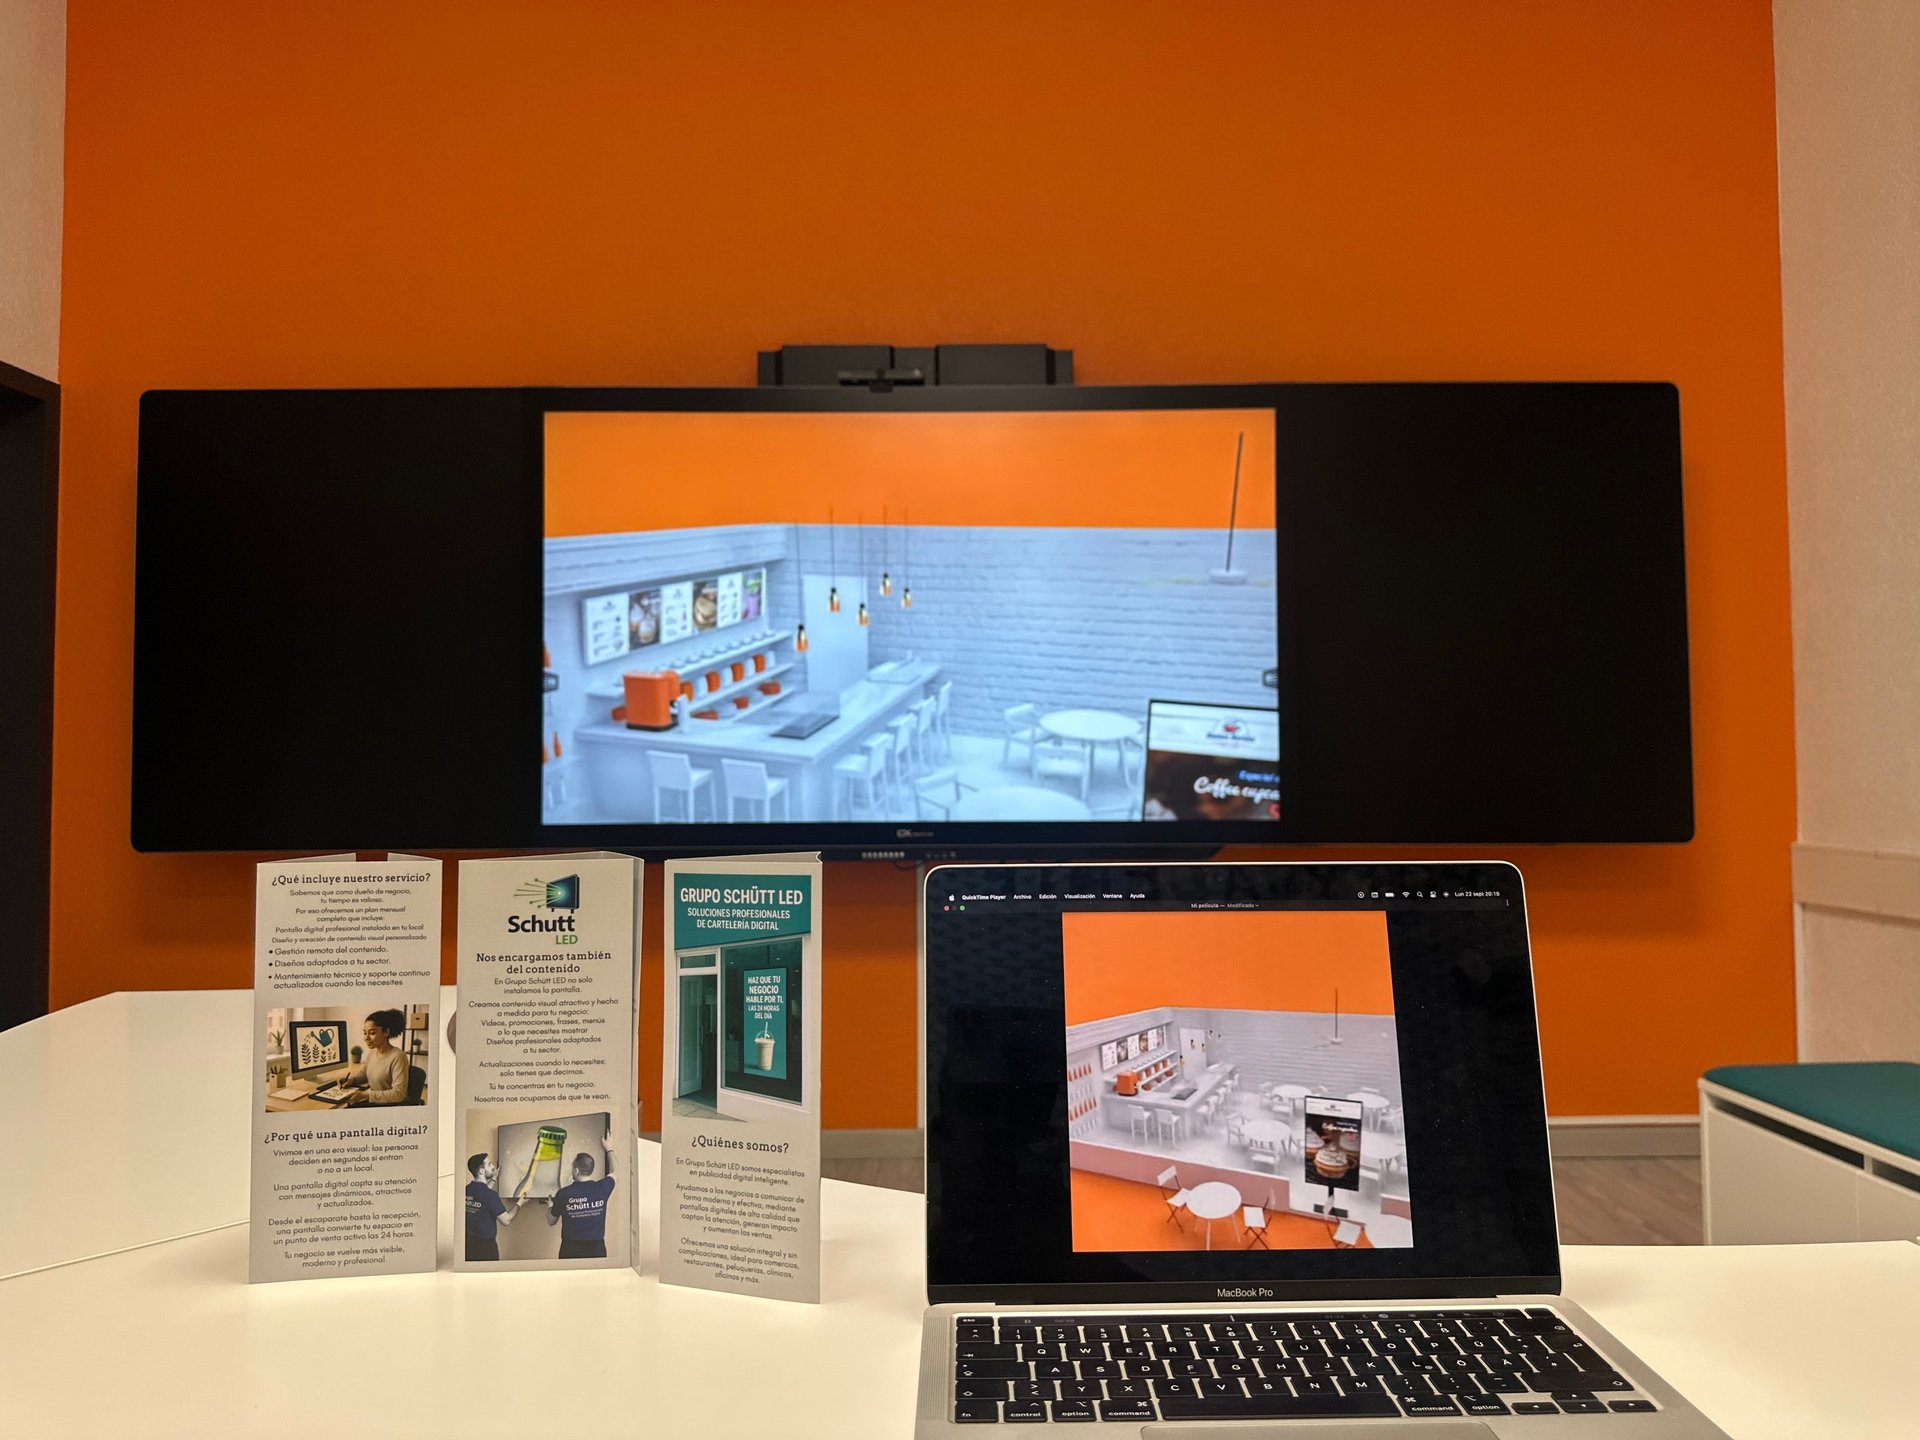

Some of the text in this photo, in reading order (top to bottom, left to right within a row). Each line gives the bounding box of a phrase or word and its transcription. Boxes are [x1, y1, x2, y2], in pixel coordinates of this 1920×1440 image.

[1194, 776, 1240, 798] Coffee
[271, 875, 299, 886] ¿Qué
[302, 874, 340, 884] incluye
[385, 873, 430, 882] servicio?
[680, 886, 802, 904] GRUPO SCHÜTT LED
[687, 907, 790, 918] SOLUCIONES PROFESIONALES
[508, 915, 575, 932] Schutt
[696, 919, 778, 930] DE CARTELERÍA DIGITAL
[556, 934, 578, 944] LED
[306, 958, 348, 966] adaptados
[476, 951, 611, 962] Nos encargamos también
[506, 964, 580, 973] del contenido
[504, 978, 527, 986] Grupo
[749, 985, 778, 994] NEGOCIO
[264, 1132, 290, 1143] ¿Por
[292, 1131, 313, 1142] qué
[339, 1127, 384, 1139] pantalla
[386, 1125, 427, 1136] digital?
[691, 1135, 788, 1152] ¿Quiénes somos?
[685, 1158, 705, 1167] Grupo
[706, 1160, 726, 1169] Schütt
[727, 1162, 740, 1170] LED
[762, 1168, 804, 1176] especialistas
[698, 1170, 731, 1179] publicidad
[732, 1173, 753, 1182] digital
[291, 1181, 323, 1191] pantalla
[324, 1180, 348, 1190] digital
[332, 1190, 373, 1199] dinámicos,
[268, 1217, 293, 1225] Desde
[1217, 1287, 1274, 1297] MacBook Pro
